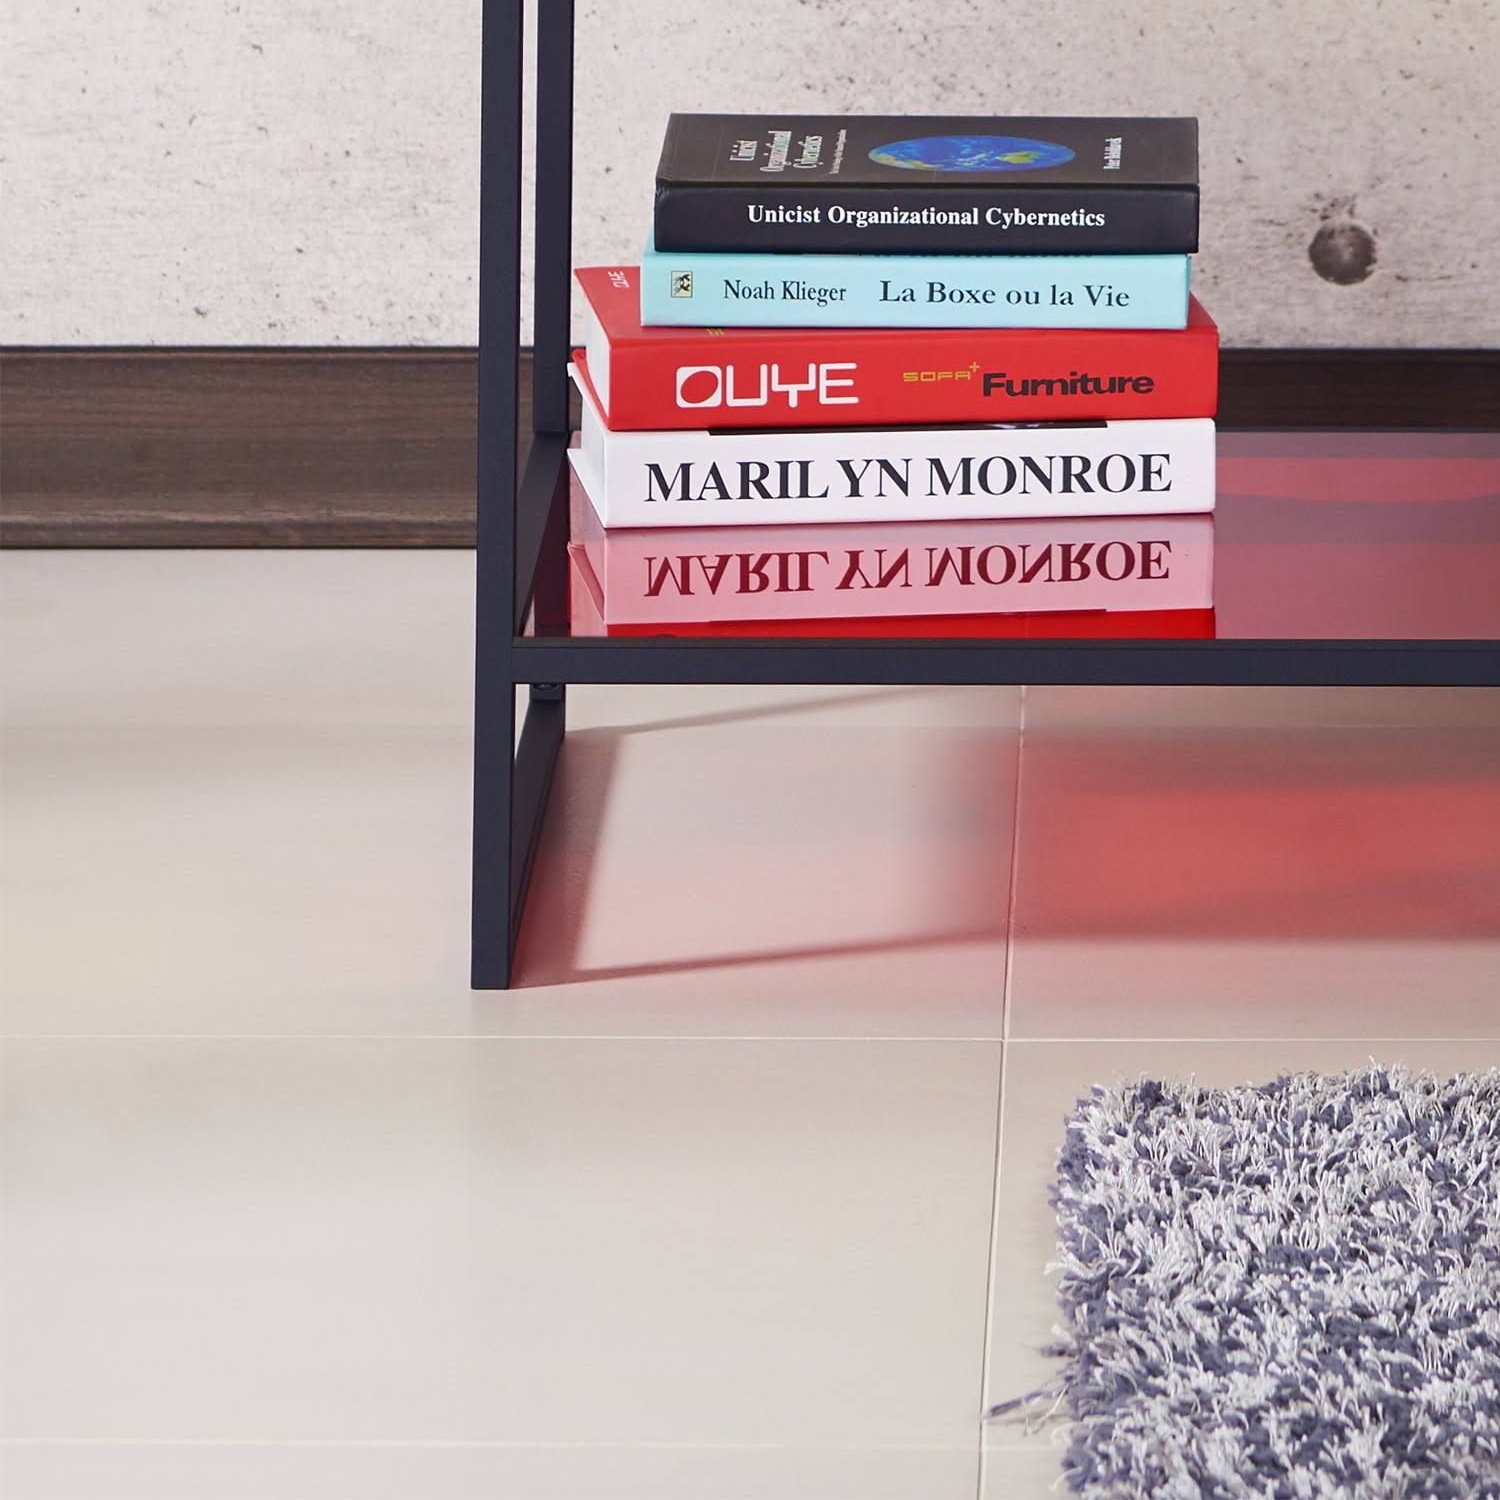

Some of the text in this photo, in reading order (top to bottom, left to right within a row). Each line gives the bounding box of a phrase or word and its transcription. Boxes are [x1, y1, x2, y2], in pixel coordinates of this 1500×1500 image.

[747, 204, 1106, 230] Unicist Organizational Cybernetics
[723, 279, 847, 307] Noah Klieger
[879, 280, 1130, 308] La Boxe ou la Vie
[676, 362, 860, 408] OUYE
[983, 371, 1155, 397] Furniture
[644, 453, 1172, 502] MARILYN MONROE
